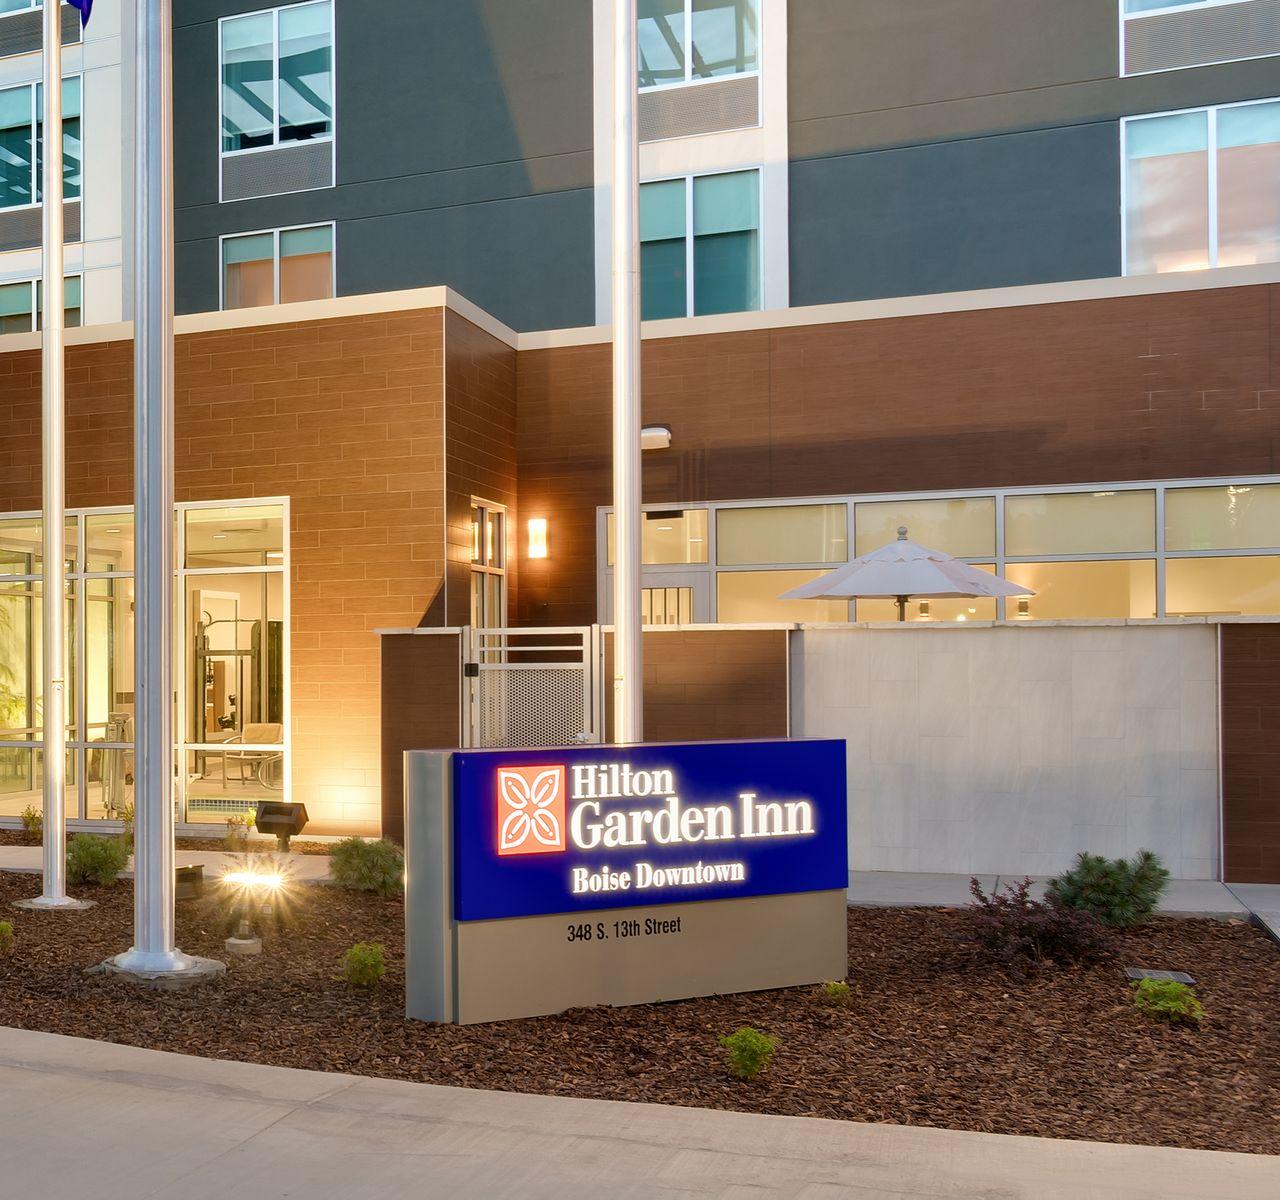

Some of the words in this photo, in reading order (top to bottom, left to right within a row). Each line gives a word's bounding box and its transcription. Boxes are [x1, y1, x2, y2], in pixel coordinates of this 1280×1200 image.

[571, 763, 676, 800] Hilton
[570, 796, 736, 850] Garden
[739, 793, 816, 839] Inn
[572, 865, 632, 894] Boise
[635, 860, 746, 889] Downtown
[567, 923, 592, 942] 348
[596, 922, 609, 940] S.
[613, 919, 641, 938] 13th
[644, 916, 682, 936] Street
